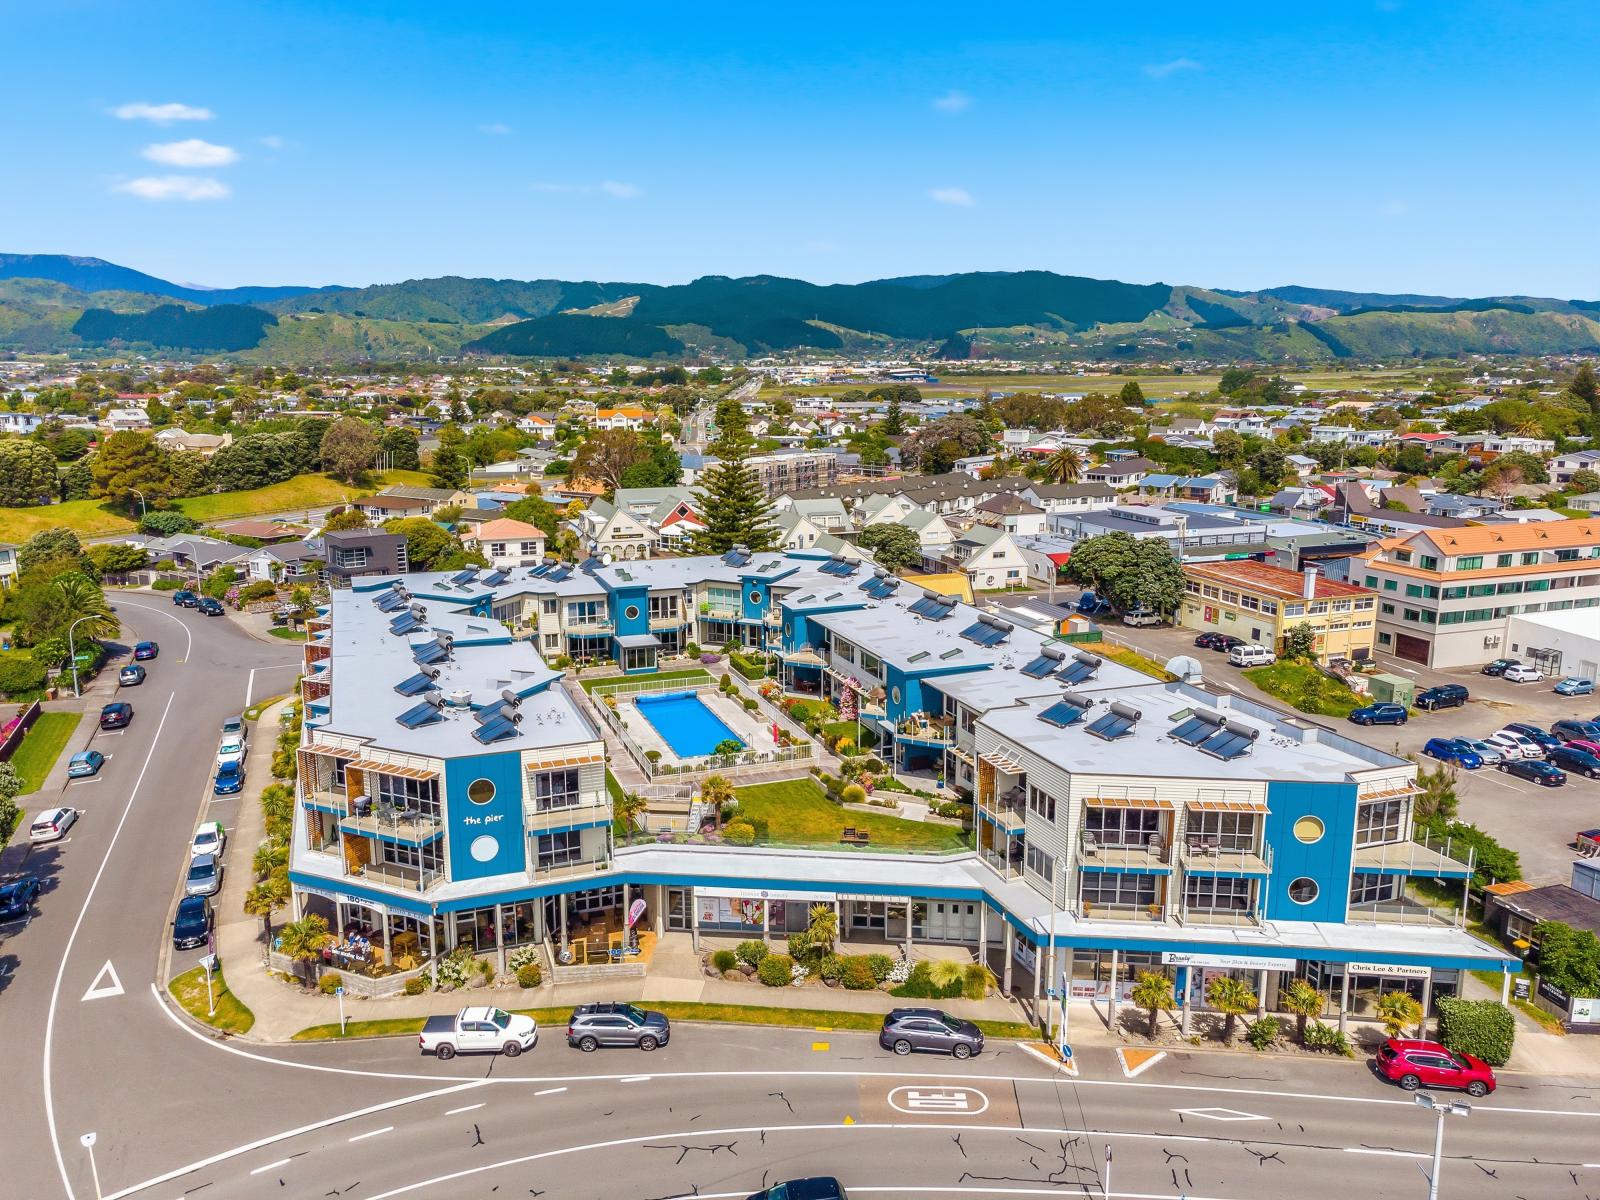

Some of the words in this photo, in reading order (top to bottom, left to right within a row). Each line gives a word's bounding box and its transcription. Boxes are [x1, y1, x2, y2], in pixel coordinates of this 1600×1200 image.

[463, 816, 481, 826] the
[484, 814, 504, 826] pier
[346, 895, 360, 904] 180
[1168, 953, 1191, 964] Beauty
[1396, 967, 1428, 975] Partners
